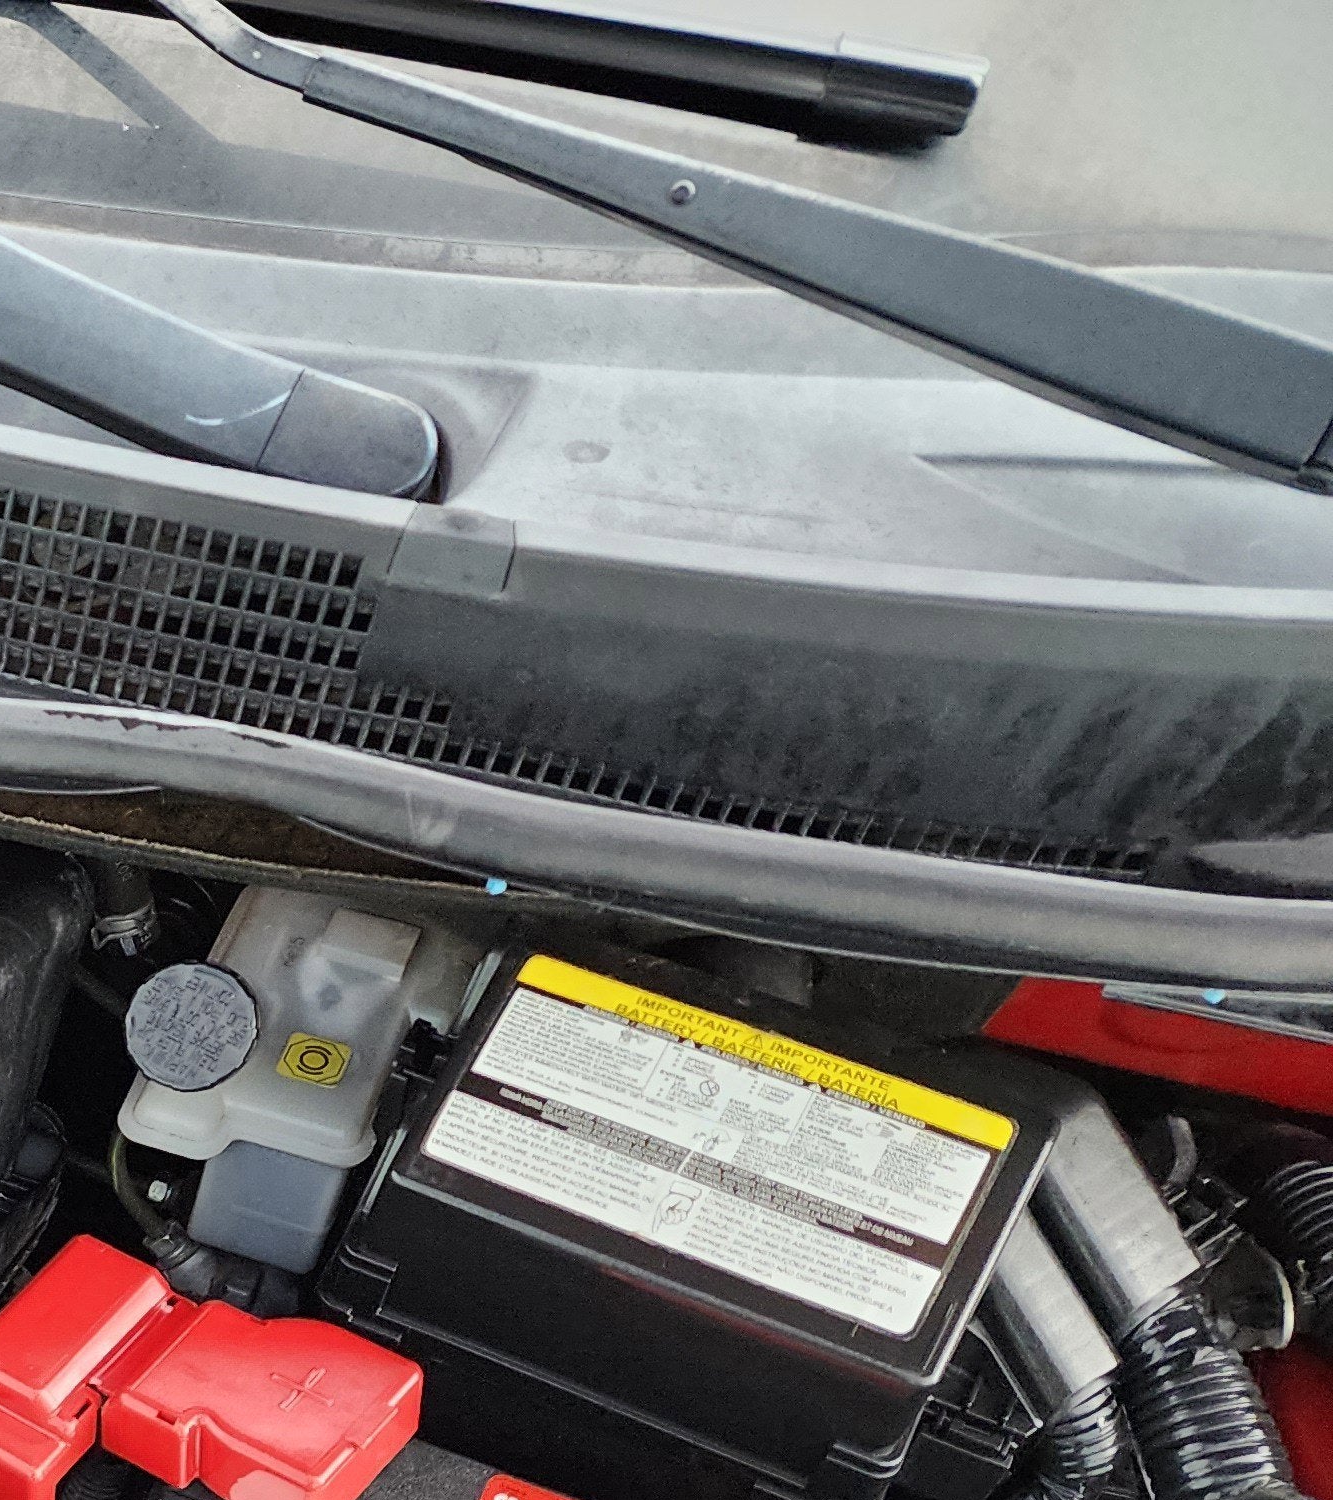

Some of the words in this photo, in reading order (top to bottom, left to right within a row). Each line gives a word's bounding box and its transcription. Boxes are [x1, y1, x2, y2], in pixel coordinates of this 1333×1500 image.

[614, 1002, 697, 1040] BATTERY
[710, 1035, 802, 1075] BATTERIE
[635, 994, 743, 1040] IMPORTANT
[768, 1040, 891, 1091] IMPORTANTE
